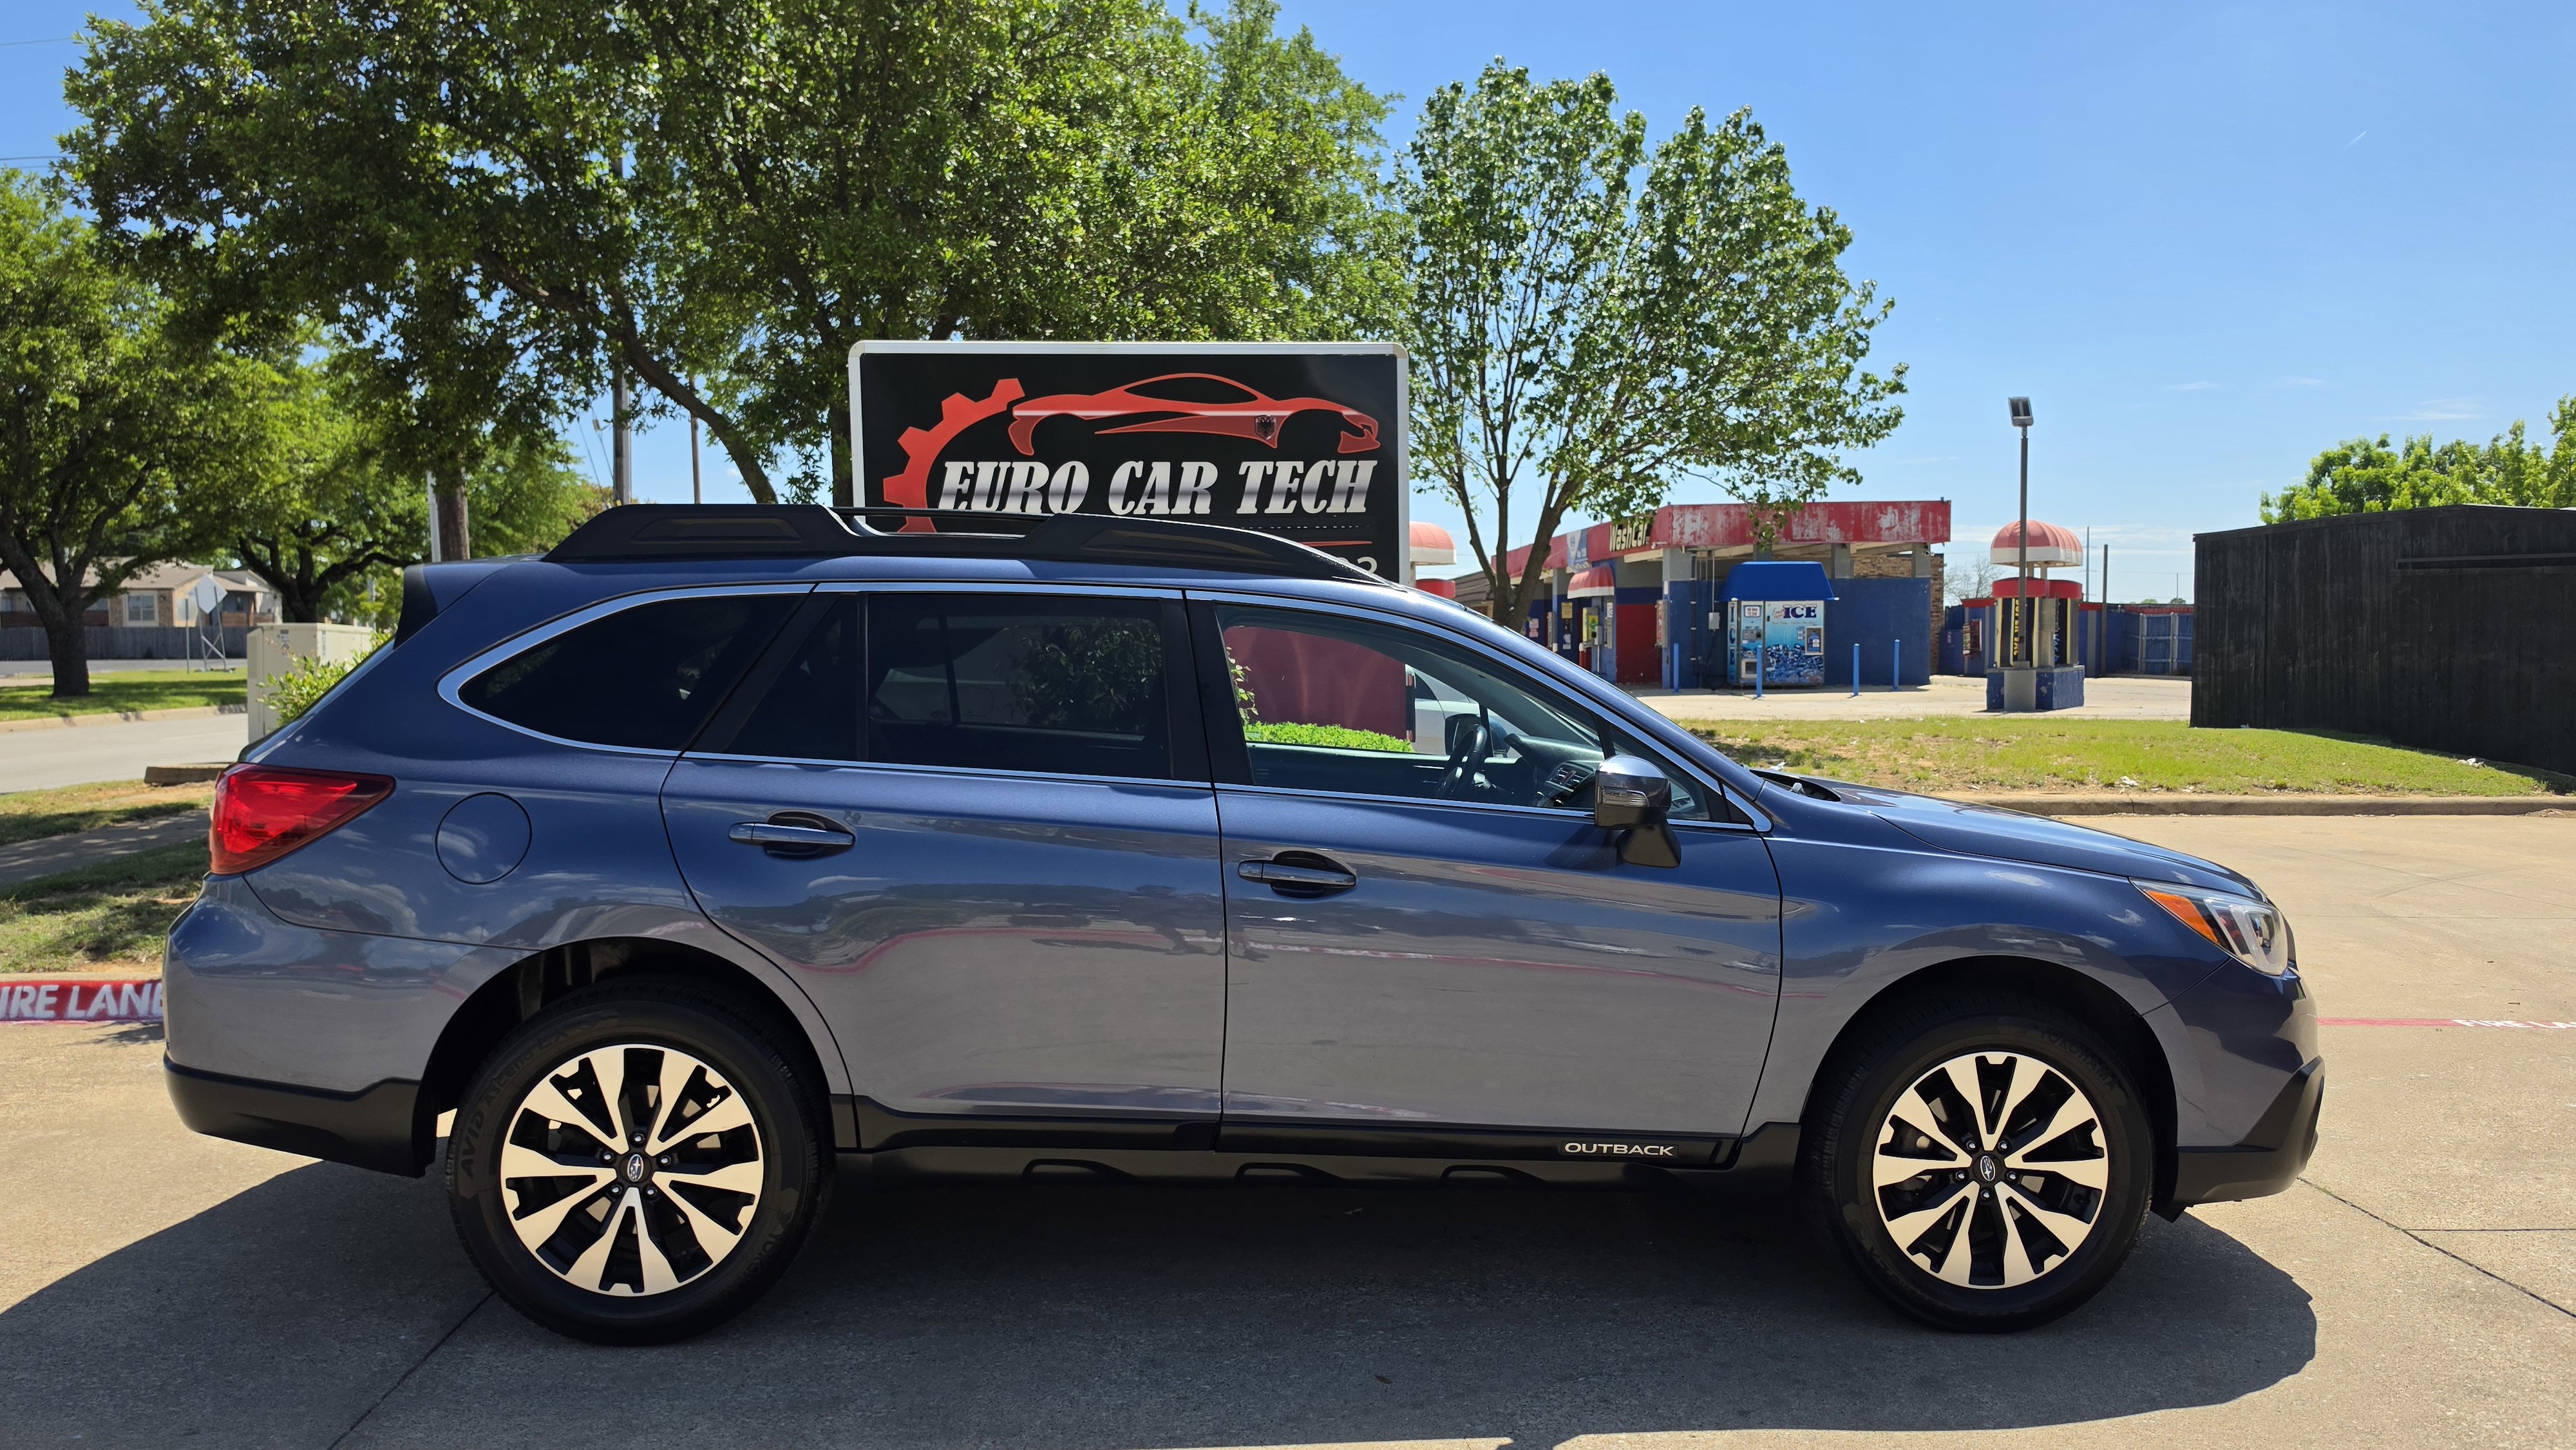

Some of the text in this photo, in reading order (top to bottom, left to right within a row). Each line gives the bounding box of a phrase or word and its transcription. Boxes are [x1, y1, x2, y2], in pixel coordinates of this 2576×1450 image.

[938, 459, 1378, 515] EURO CAR TECH
[1783, 604, 1817, 619] ICE
[2452, 1019, 2576, 1029] FIRE LA
[2036, 1025, 2120, 1092] YOKOHAMA
[461, 1106, 488, 1178] AVID
[1564, 1142, 1674, 1157] OUTBACK
